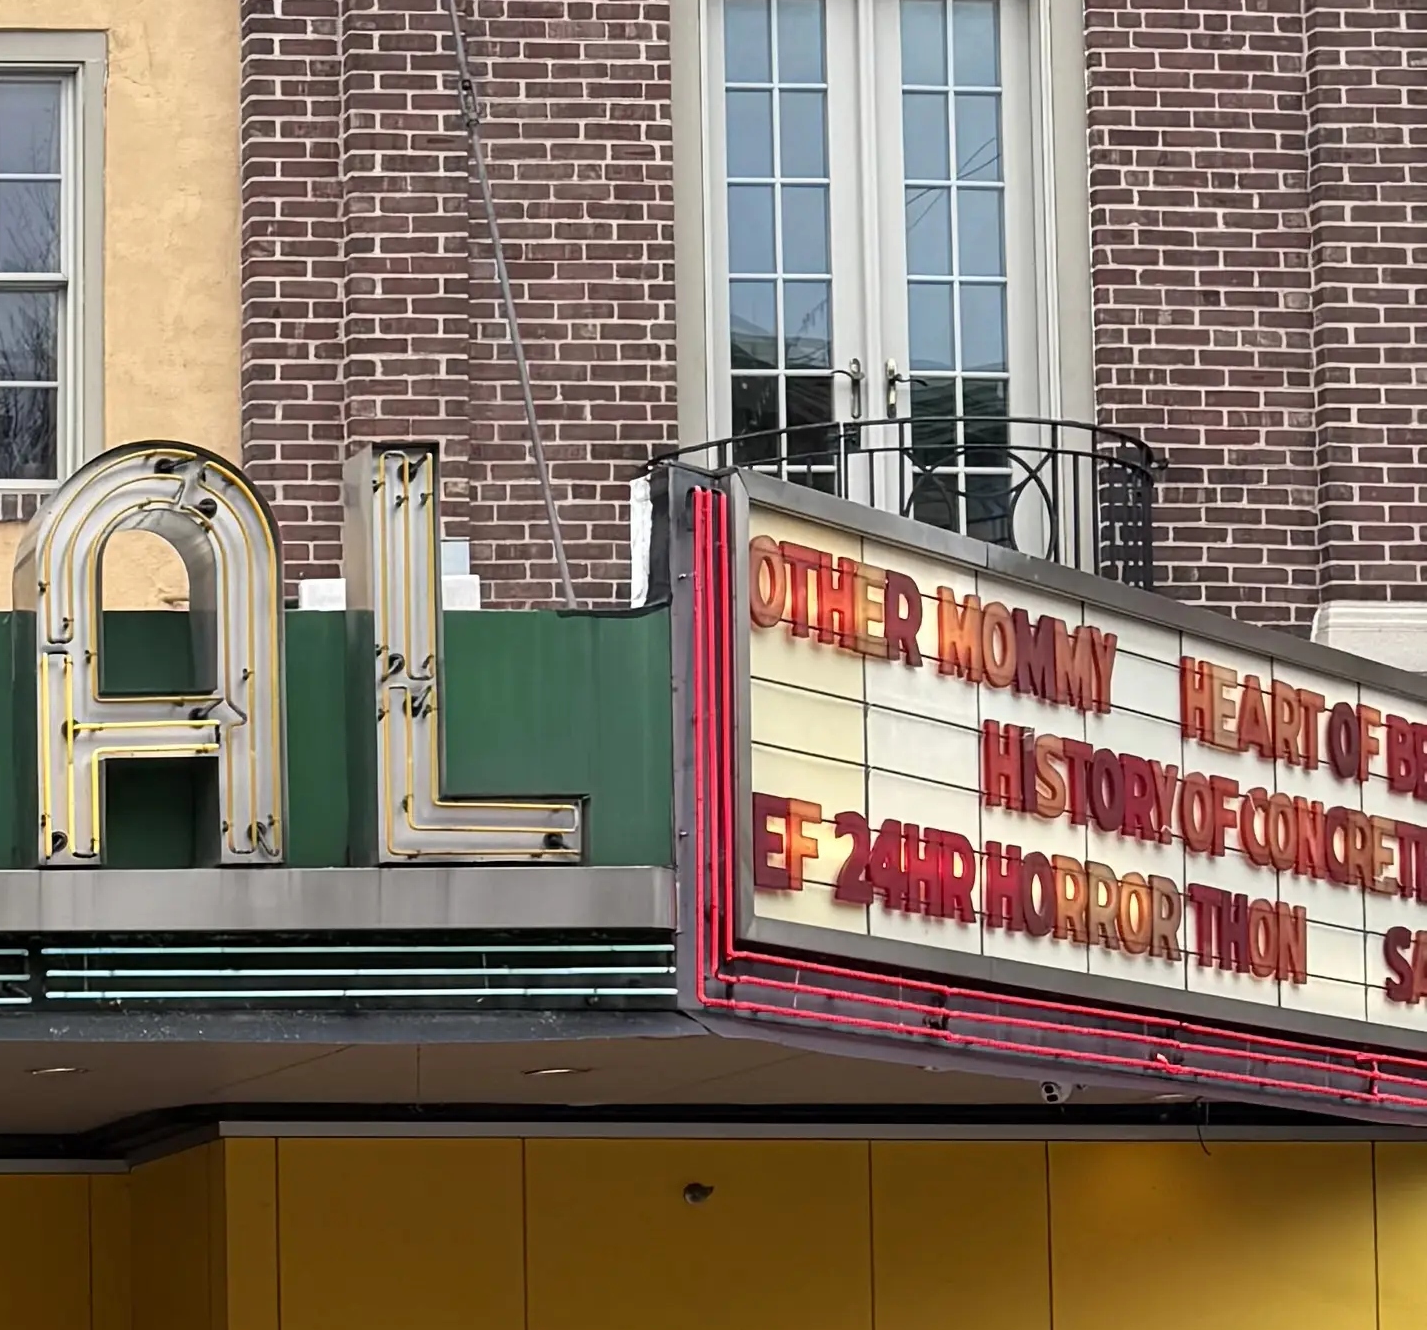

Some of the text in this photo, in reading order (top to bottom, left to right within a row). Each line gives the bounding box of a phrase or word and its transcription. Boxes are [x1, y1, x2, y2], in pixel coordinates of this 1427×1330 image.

[749, 535, 923, 667] OTHER
[936, 585, 1118, 715] MOMMY
[1179, 655, 1325, 770] HEART
[1328, 701, 1381, 782] OF
[983, 719, 1178, 844] HISTORY
[1180, 771, 1239, 857] OF
[752, 792, 823, 891] EF
[834, 811, 976, 924] 24HR
[984, 840, 1182, 960] HORROR
[1187, 882, 1308, 985] THON
